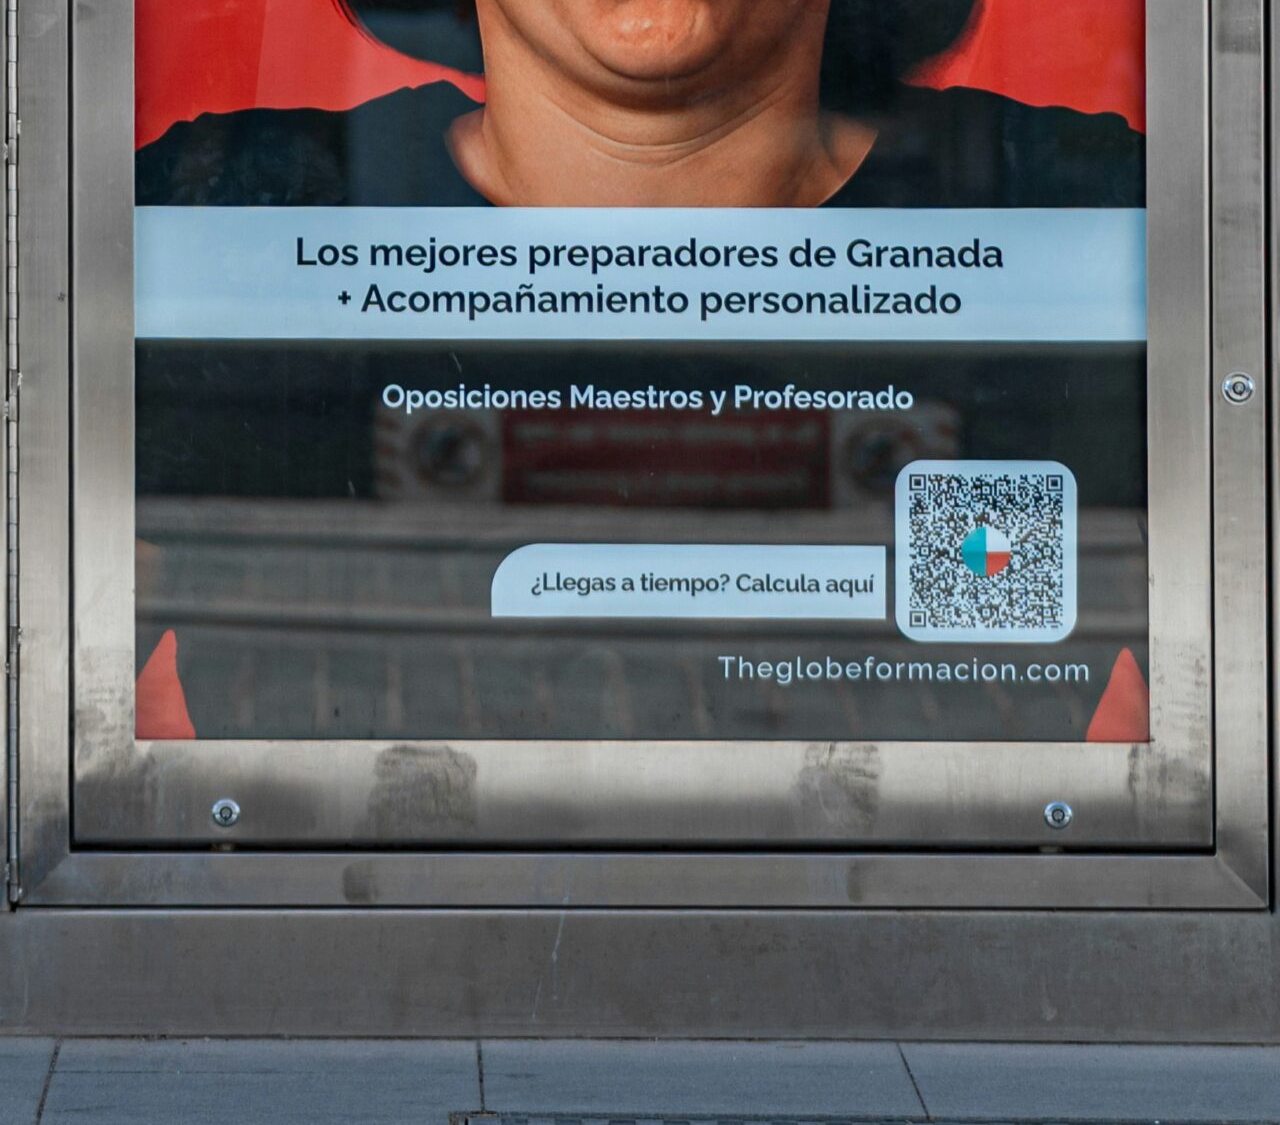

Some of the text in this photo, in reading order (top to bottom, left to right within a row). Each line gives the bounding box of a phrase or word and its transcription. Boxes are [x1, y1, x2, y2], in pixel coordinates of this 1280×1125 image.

[297, 236, 1004, 275] Los mejores preparadores de Granada
[337, 283, 962, 322] + Acompañamiento personalizado
[382, 383, 914, 416] Oposiciones Maestros y Profesorado
[531, 571, 874, 598] ¿Llegas a tiempo? Calcula aquí
[717, 655, 1090, 685] Theglobeformacion.com
